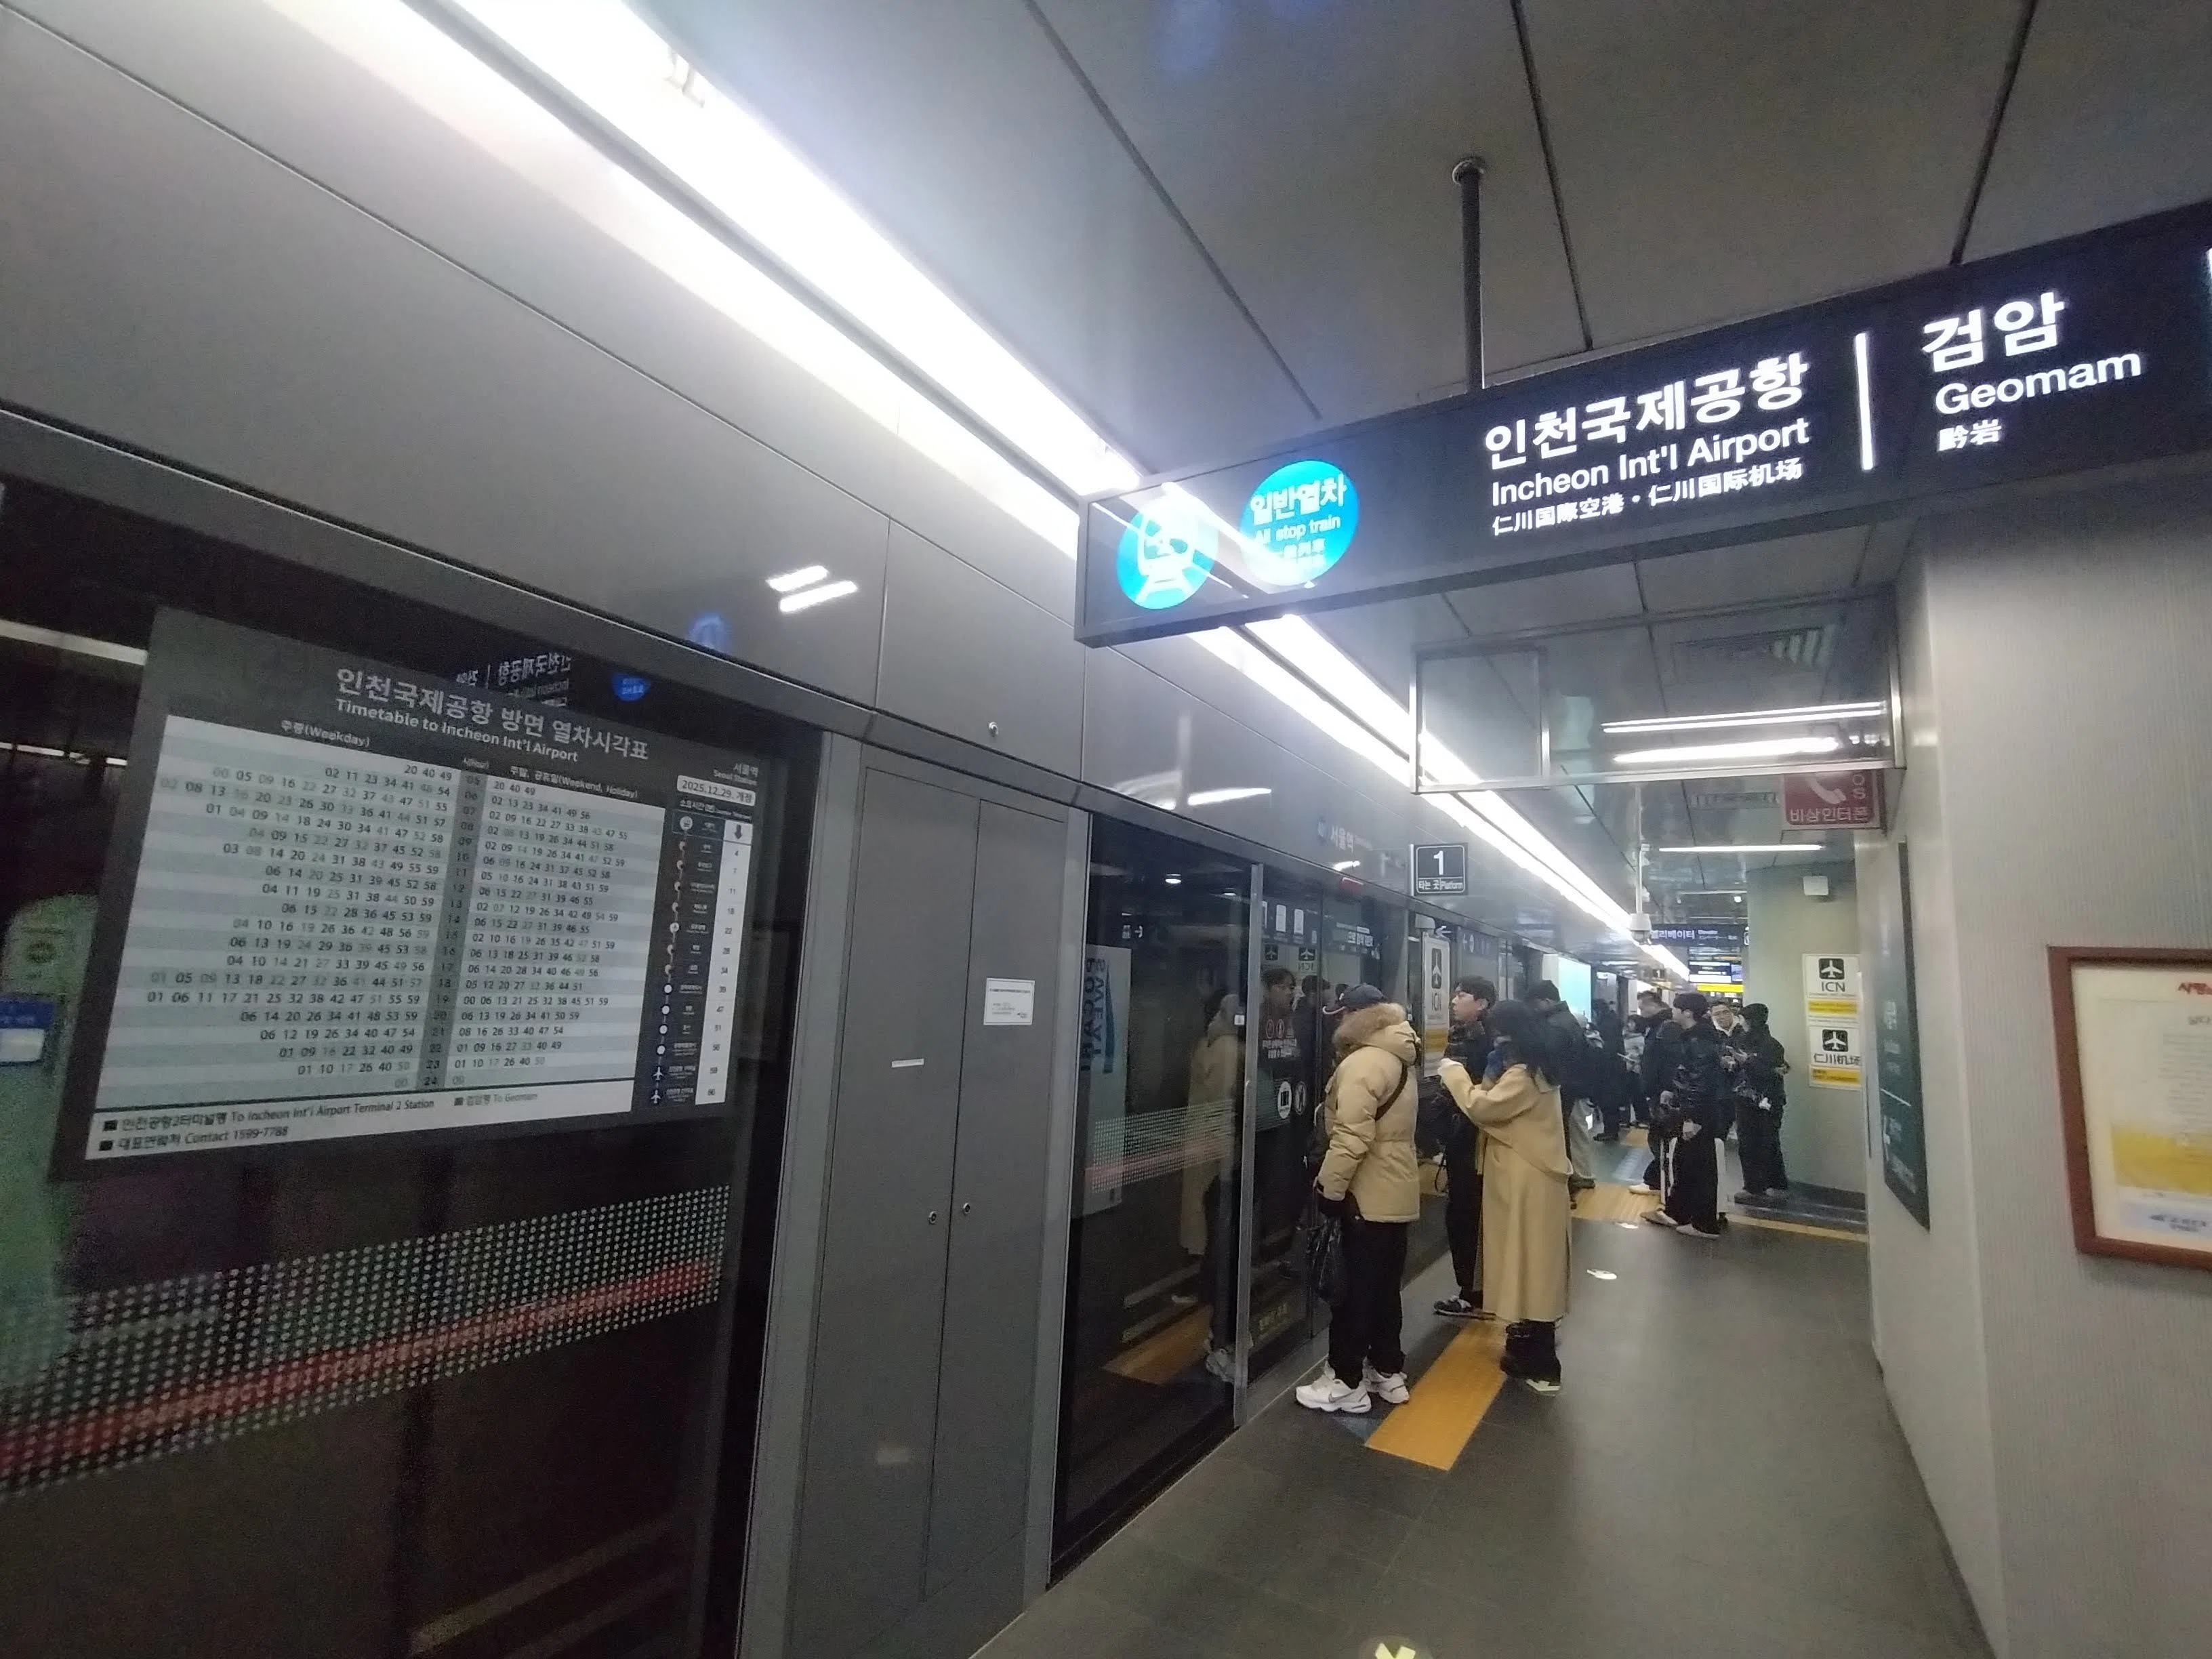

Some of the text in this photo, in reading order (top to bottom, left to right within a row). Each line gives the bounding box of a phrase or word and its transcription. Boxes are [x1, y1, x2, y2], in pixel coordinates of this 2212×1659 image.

[1922, 291, 2065, 372] 검암
[1936, 352, 2141, 414] Geomam
[1486, 352, 1810, 470] 인천국제공항
[1492, 417, 1810, 506] Incheon Int'l Airport
[1251, 472, 1347, 525] 일반열차
[1276, 523, 1306, 541] stop
[1309, 515, 1340, 534] train
[337, 668, 493, 724] 인천국제공항
[501, 707, 544, 737] 방면
[552, 720, 649, 760] 열차시각표
[335, 698, 578, 763] Timetable to Incheon Int'l Airport
[1852, 774, 1866, 799] OS
[1790, 807, 1868, 822] 비상인터폰
[1433, 851, 1443, 876] 1
[1418, 880, 1431, 890] 타는
[1822, 981, 1845, 992] ICN
[316, 1105, 350, 1118] Airport
[354, 1101, 394, 1113] Terminal
[404, 1099, 434, 1111] Station
[185, 1131, 228, 1145] Contact
